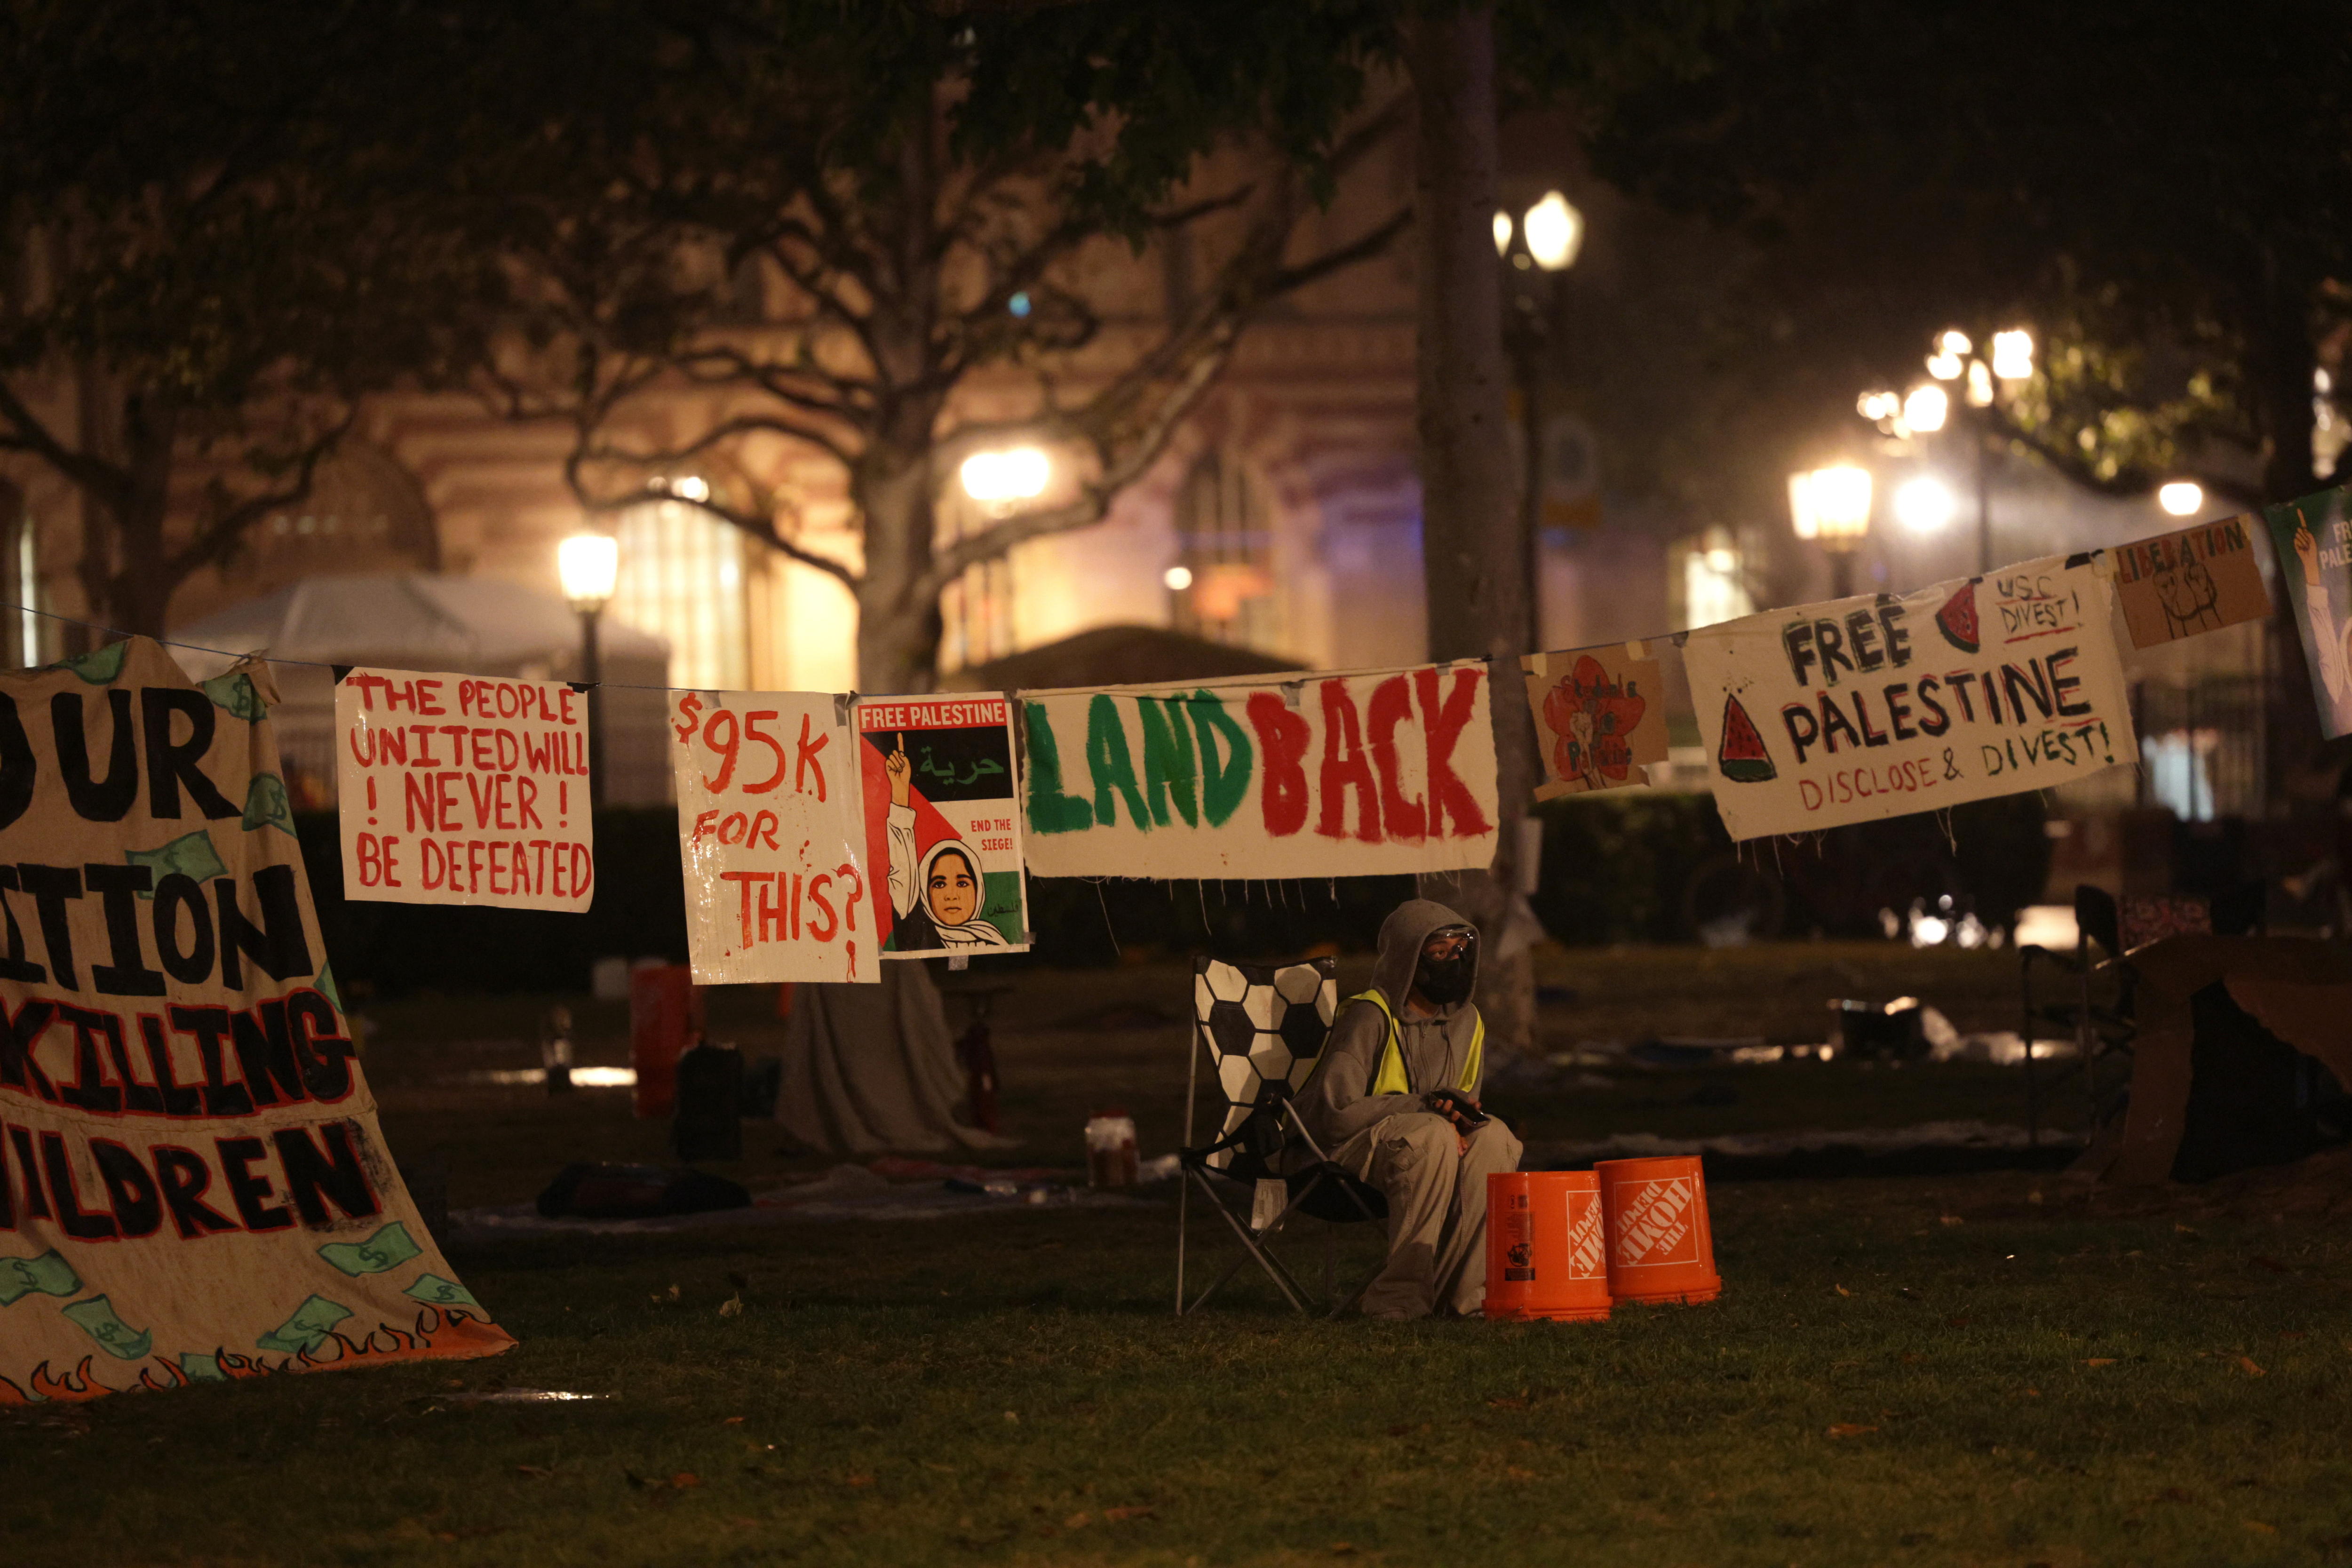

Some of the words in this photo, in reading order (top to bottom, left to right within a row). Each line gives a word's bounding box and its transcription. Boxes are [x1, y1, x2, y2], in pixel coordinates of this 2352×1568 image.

[2116, 522, 2244, 583] LIBERATION
[1998, 575, 2051, 601] USC
[2000, 586, 2083, 635] DIVEST!
[1782, 593, 1913, 688] FREE
[346, 672, 446, 715] THE
[459, 679, 577, 725] PEOPLE
[861, 707, 906, 729] FREE
[911, 702, 1004, 727] PALESTINE
[1780, 647, 2093, 765] PALESTINE
[350, 725, 519, 772] UNITED
[524, 731, 588, 775] WILL
[920, 746, 1004, 786] حرية
[1025, 688, 1253, 836] LAND
[1246, 667, 1494, 844] BACK
[1799, 758, 1937, 811] DISCLOSE
[1944, 747, 1963, 780] &
[1981, 723, 2114, 776] DIVEST!
[405, 772, 542, 833] NEVER
[691, 809, 780, 851] FOR
[971, 820, 991, 832] END
[994, 819, 1011, 831] THE
[357, 832, 401, 887] BE
[420, 837, 592, 898] DEFEATED
[982, 838, 1013, 851] SIEGE!
[720, 863, 863, 957] THIS?
[0, 986, 358, 1119] KILLING
[1616, 1181, 1664, 1236] DEPOT
[1617, 1179, 1692, 1266] HOME
[1656, 1221, 1689, 1256] THE
